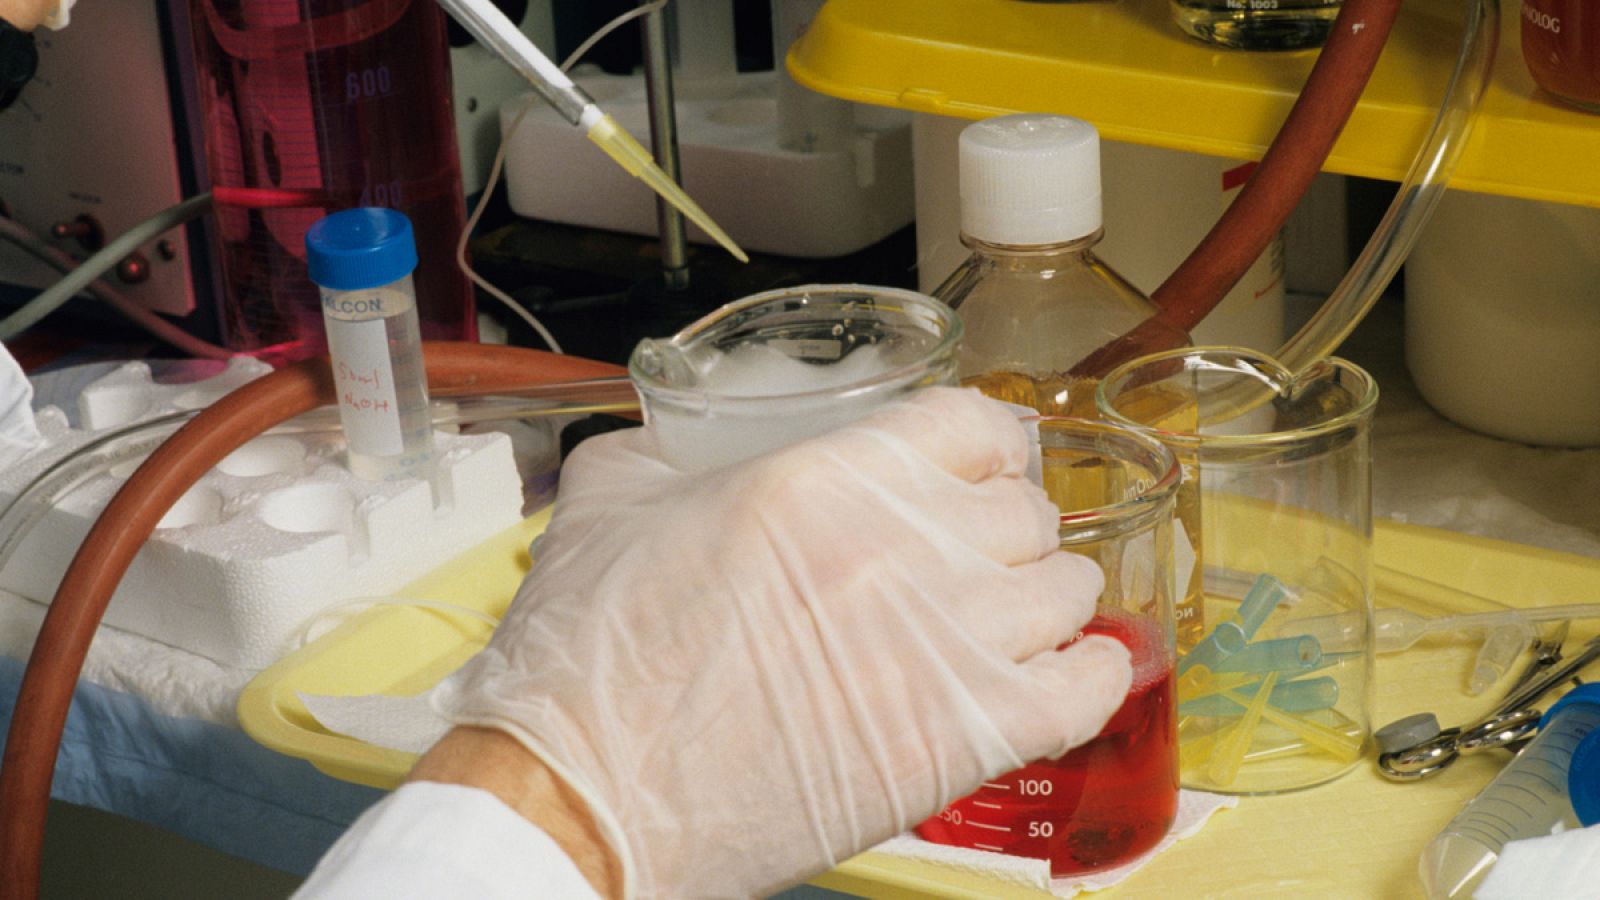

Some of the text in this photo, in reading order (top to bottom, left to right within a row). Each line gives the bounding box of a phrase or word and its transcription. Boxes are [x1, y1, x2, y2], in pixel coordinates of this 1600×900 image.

[345, 65, 391, 100] 600
[1018, 779, 1053, 796] 100
[938, 807, 962, 825] 50
[1028, 820, 1053, 837] 50
